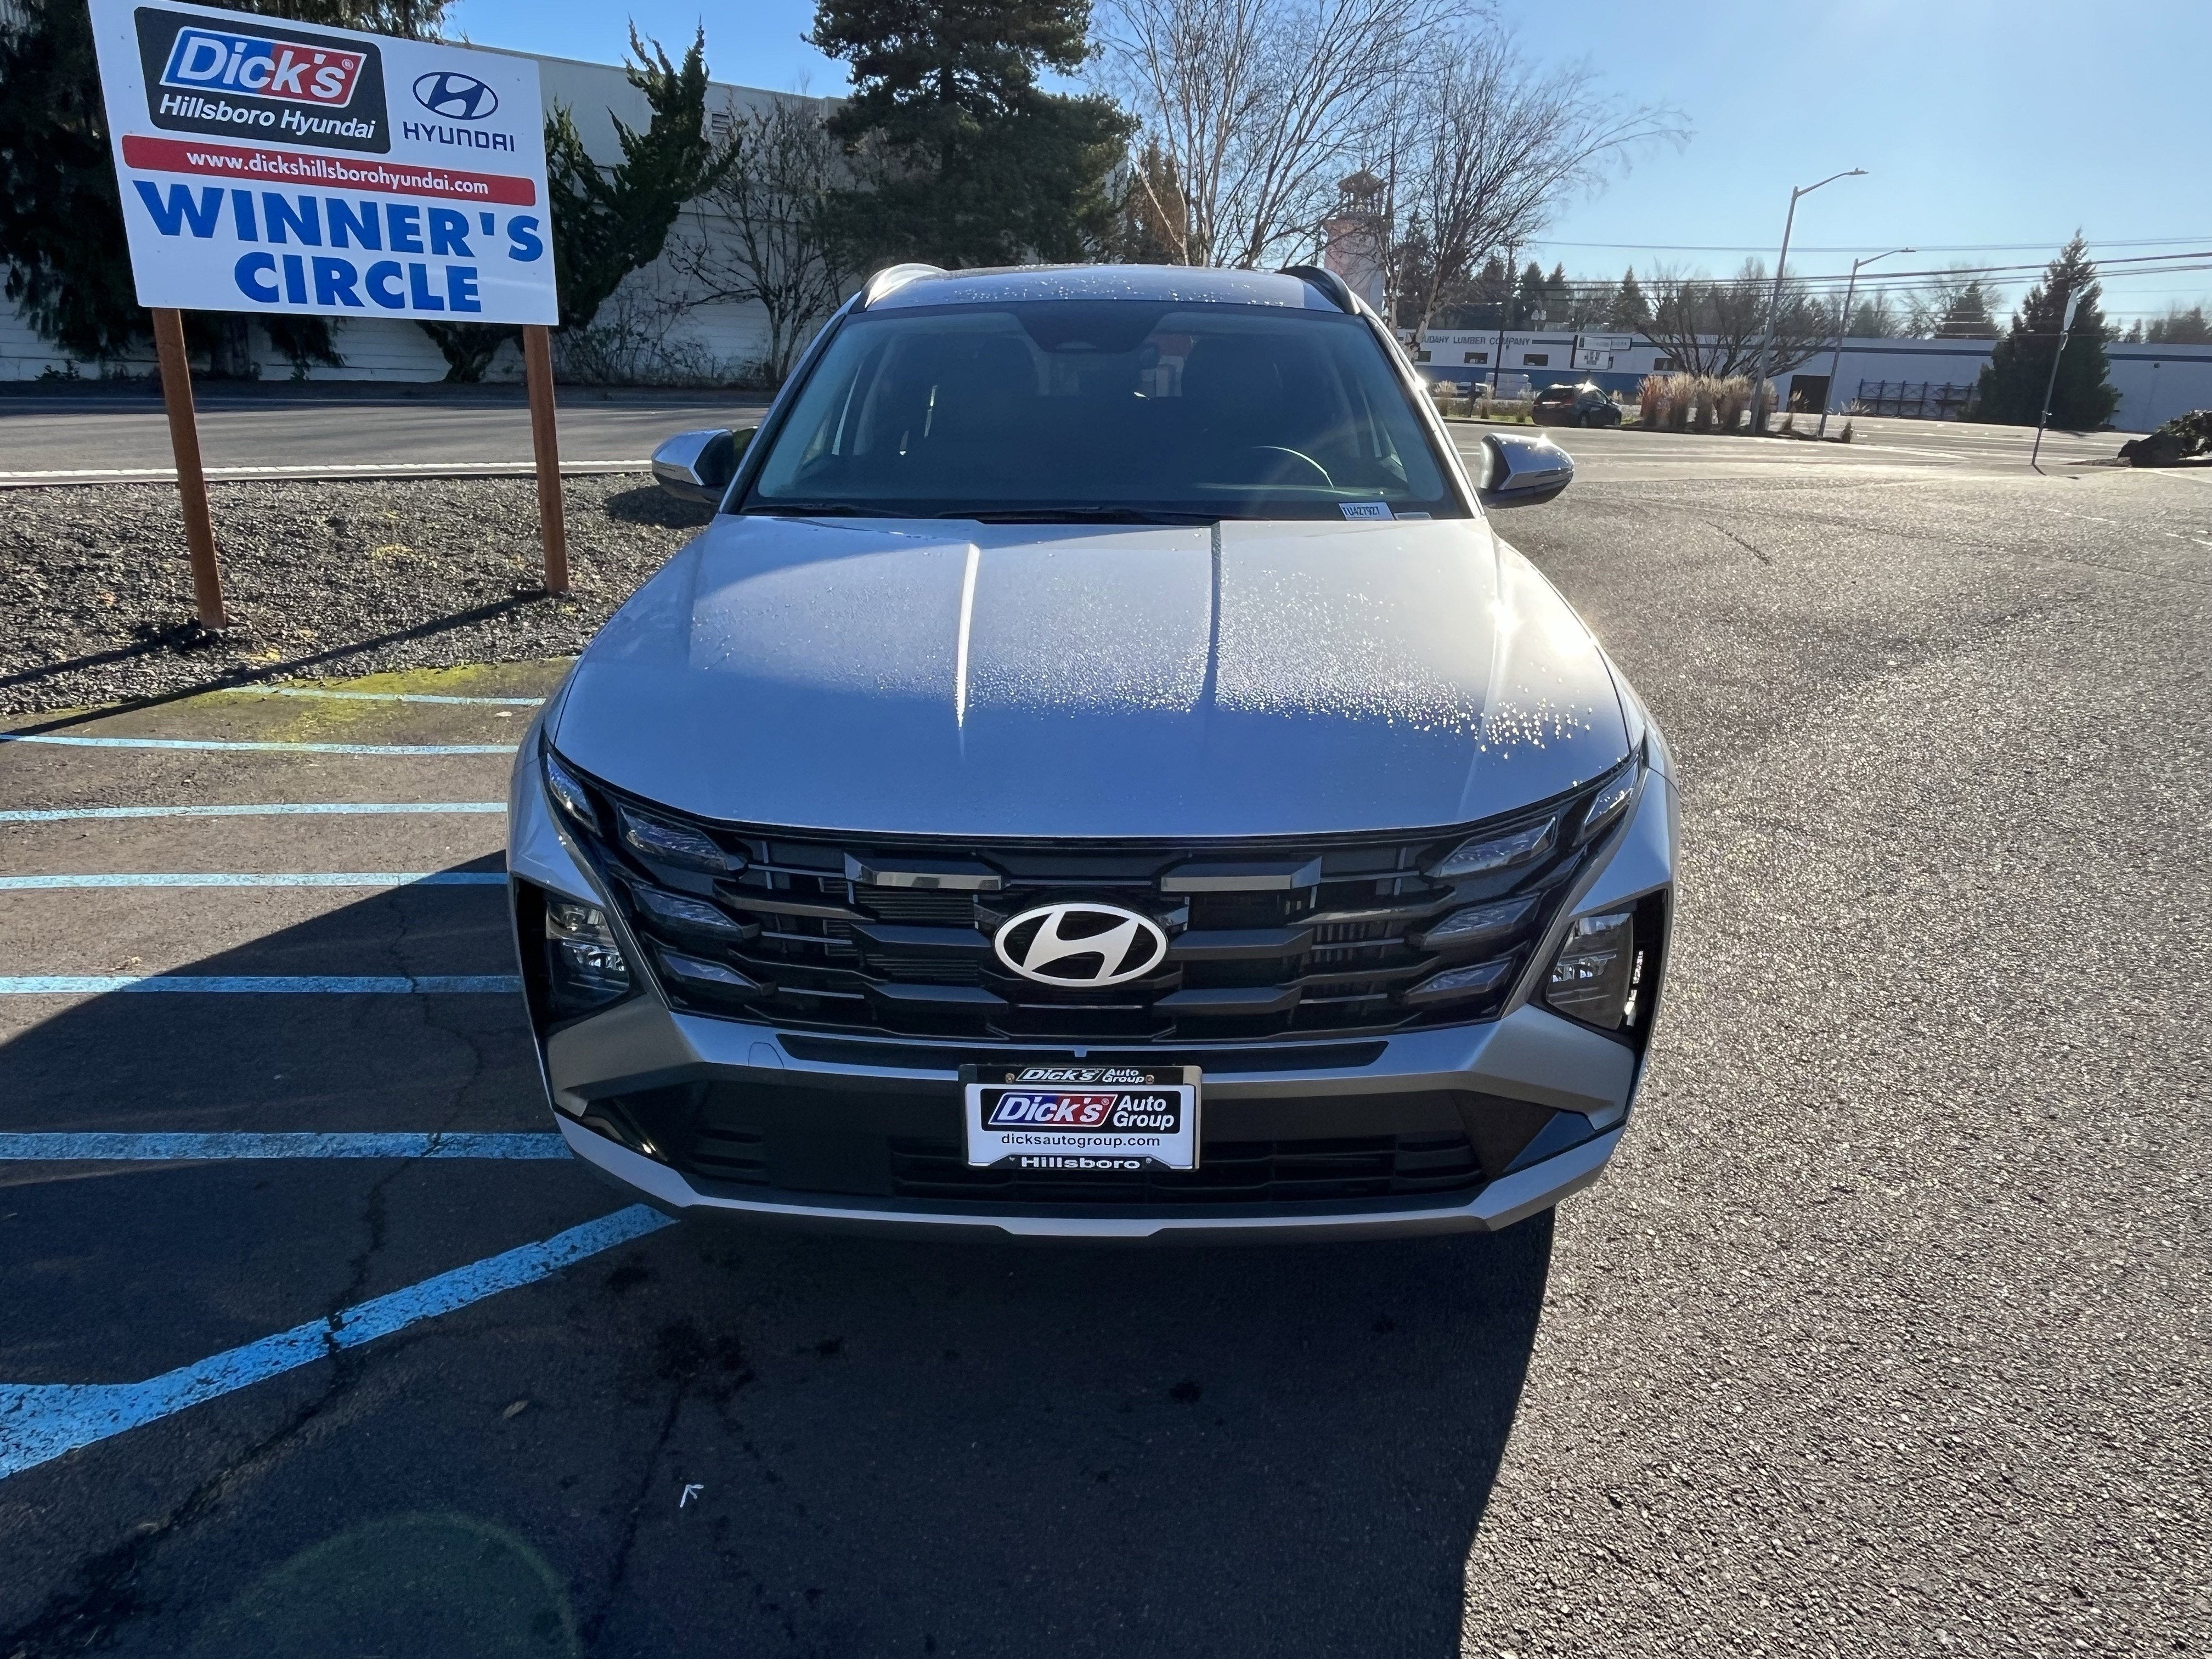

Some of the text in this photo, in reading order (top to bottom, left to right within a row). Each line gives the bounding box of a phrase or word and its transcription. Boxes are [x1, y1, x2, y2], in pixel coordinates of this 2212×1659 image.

[177, 36, 347, 99] Dick's
[160, 94, 376, 140] Hillsboro Hyundai
[403, 122, 515, 152] HYUNDAI
[187, 151, 489, 195] www.dickshillsborohyundai.com
[132, 180, 543, 262] WINNER'S
[234, 252, 481, 313] CIRCLE
[1453, 336, 1486, 345] LUMBER
[1022, 1068, 1139, 1081] Dick's Auto
[1102, 1075, 1144, 1084] Group
[997, 1096, 1166, 1122] Dick's Auto
[1113, 1111, 1175, 1131] Group
[1001, 1133, 1160, 1148] dicksautogroup.com
[1021, 1157, 1140, 1169] Hillsboro
